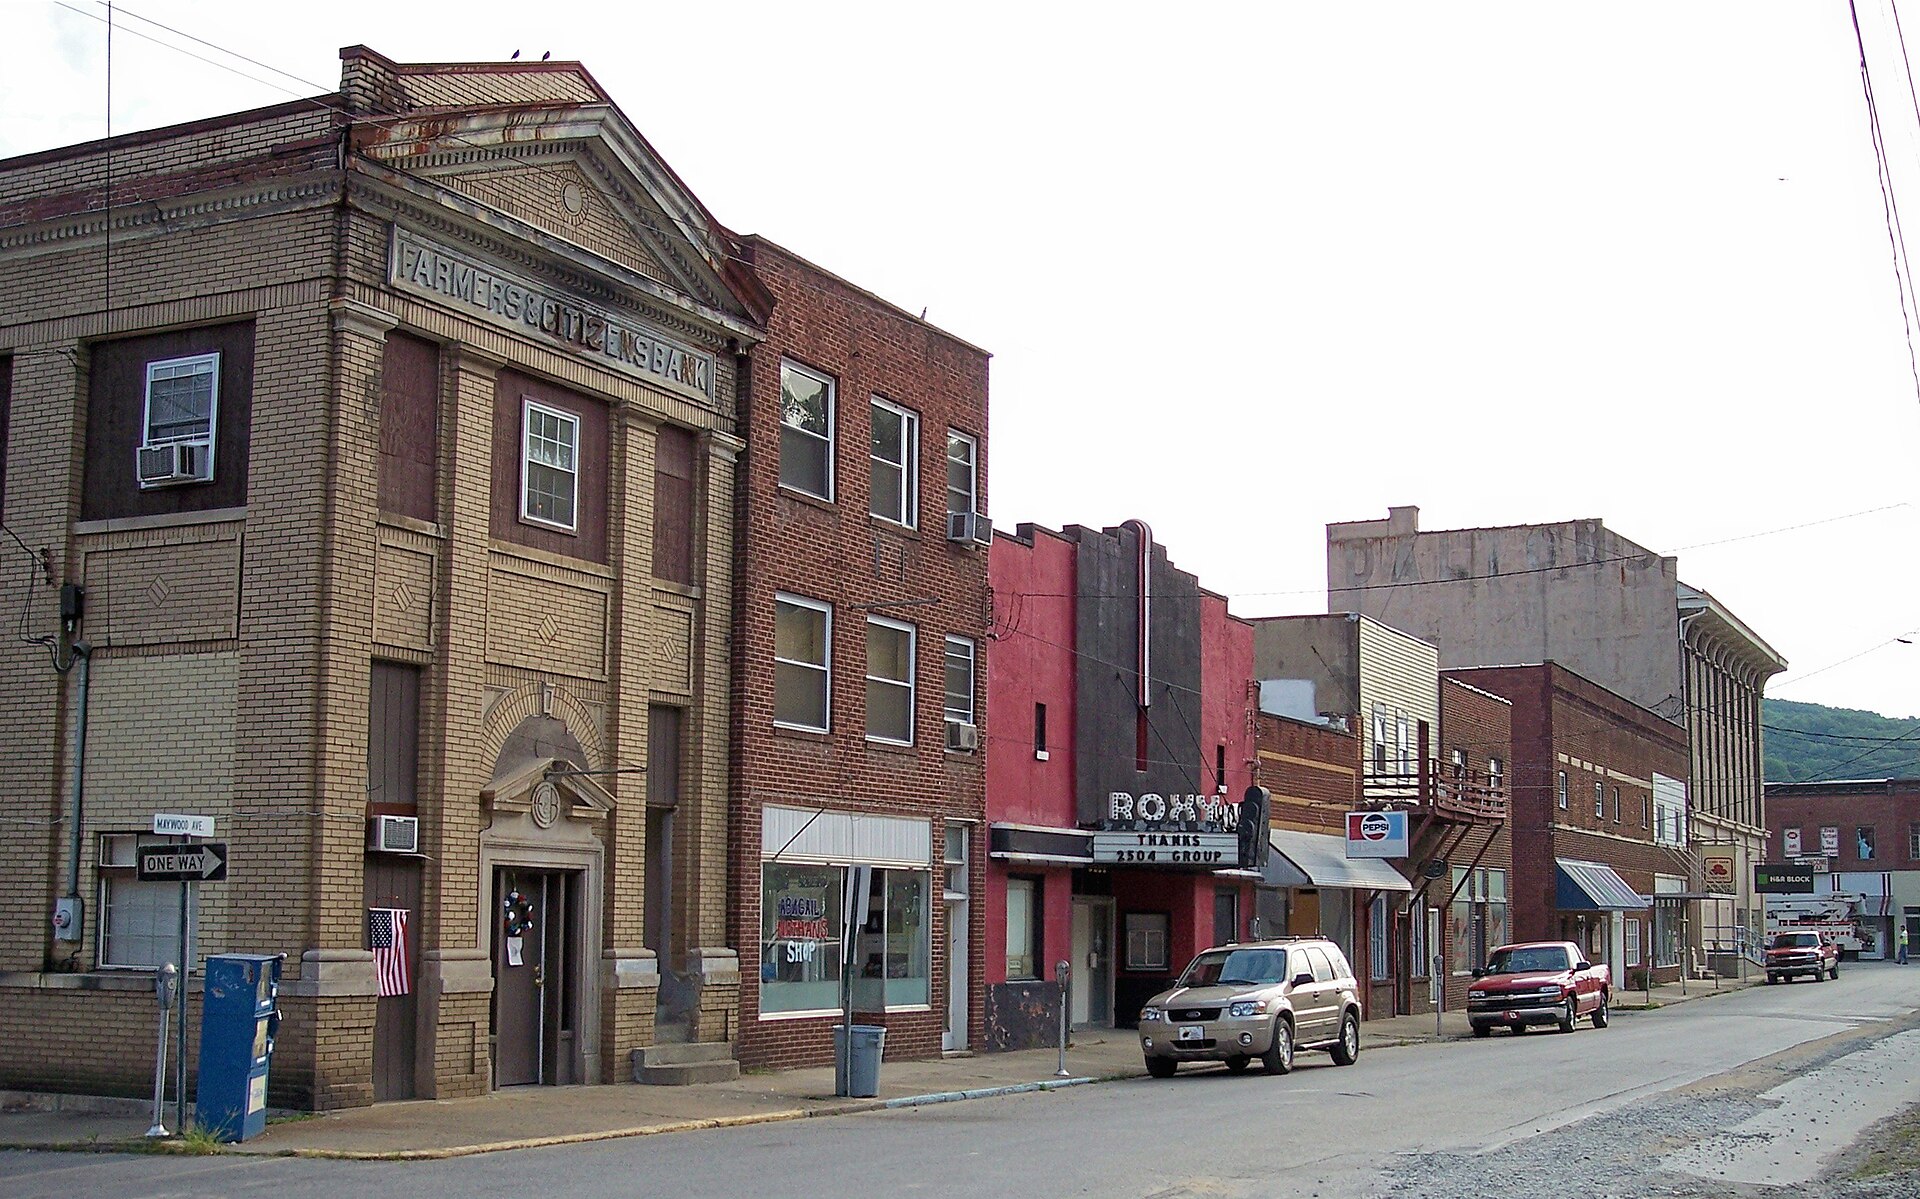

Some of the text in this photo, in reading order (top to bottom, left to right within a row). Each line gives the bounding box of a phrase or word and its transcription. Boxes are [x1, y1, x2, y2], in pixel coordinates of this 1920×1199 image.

[1108, 791, 1220, 822] ROXY
[156, 818, 189, 831] MAYWOOD
[1362, 823, 1390, 832] PEPSI
[1137, 834, 1201, 847] THANKS
[147, 855, 206, 871] ONE WAY
[1116, 850, 1222, 863] 2504 GROUP
[786, 940, 816, 963] SHOP
